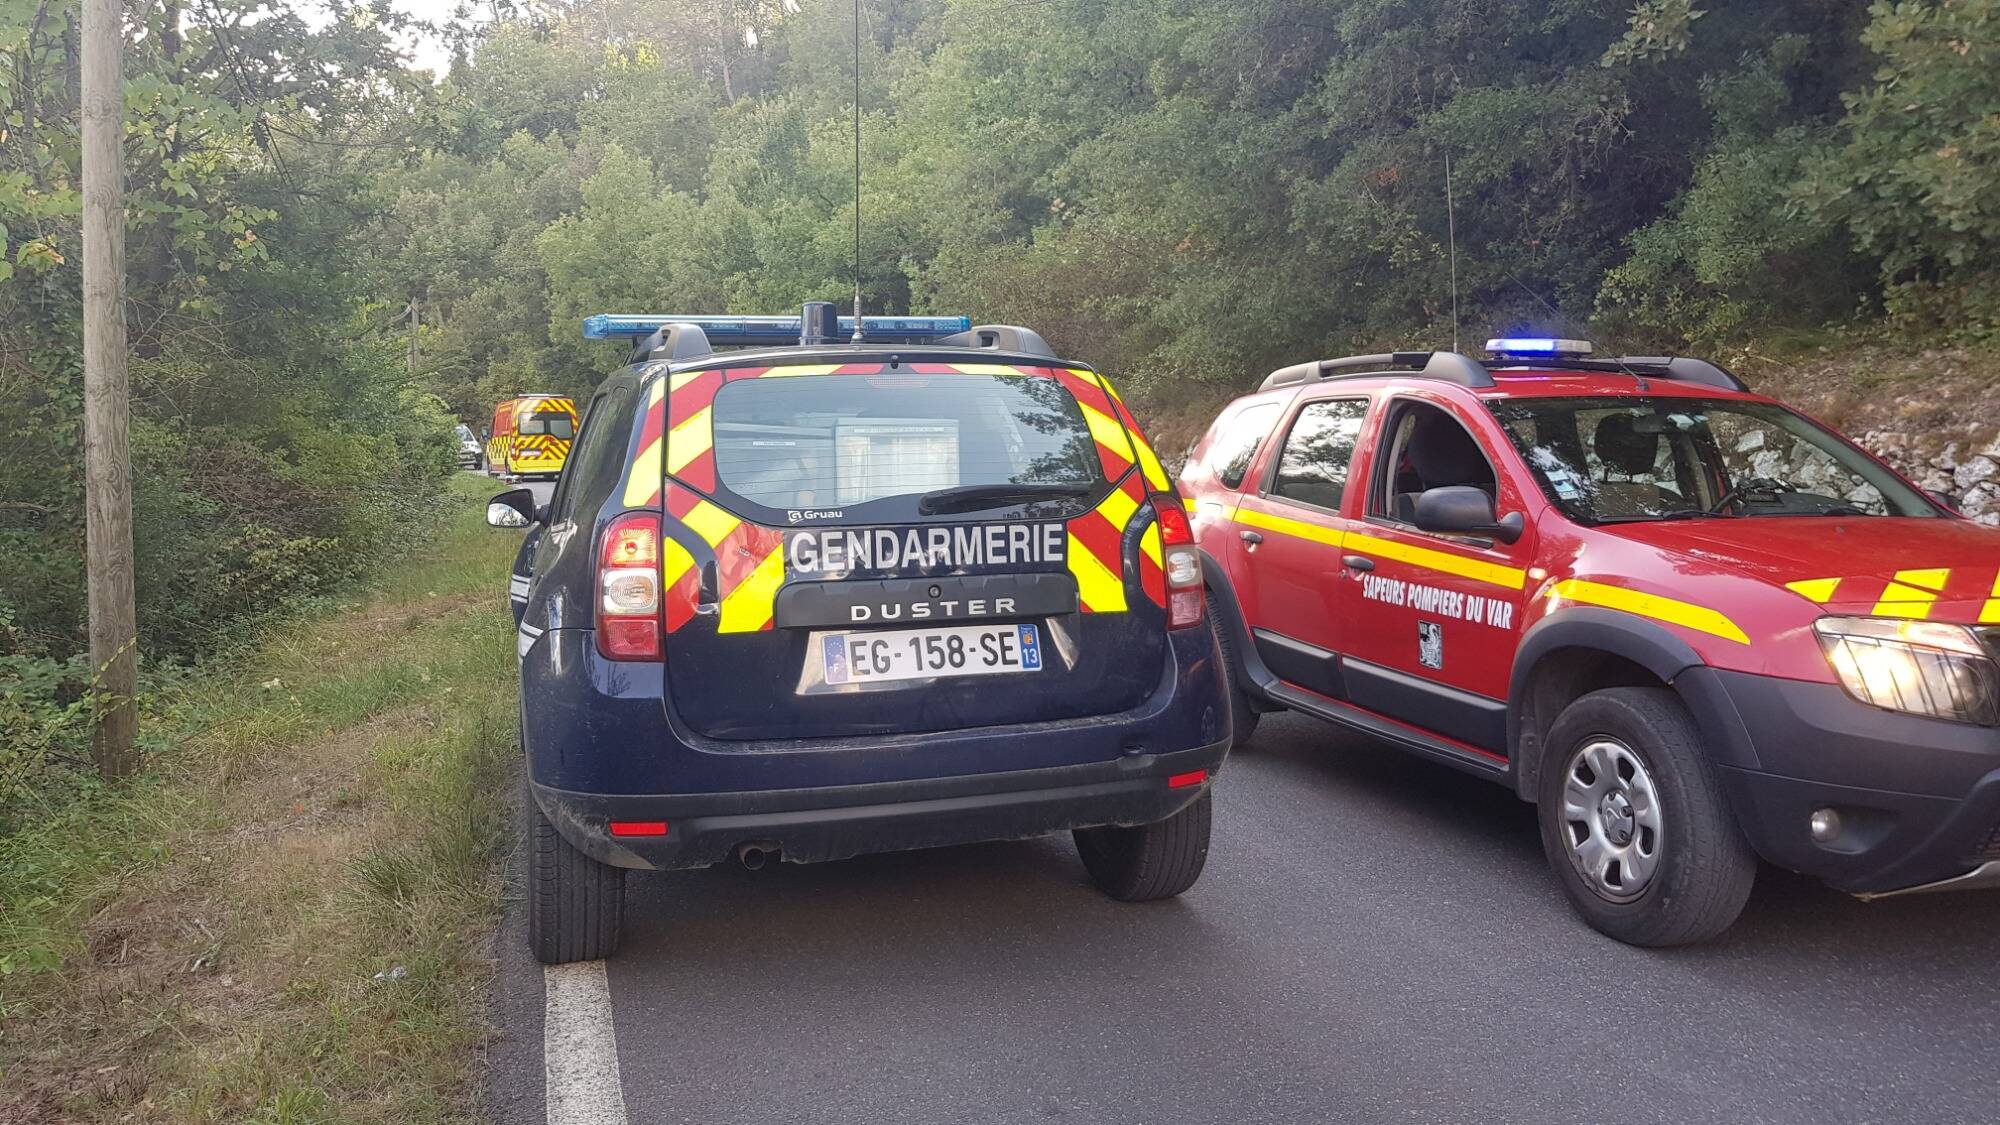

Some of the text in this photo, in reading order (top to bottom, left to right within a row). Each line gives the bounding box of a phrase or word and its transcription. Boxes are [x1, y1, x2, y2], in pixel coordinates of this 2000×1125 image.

[803, 510, 843, 519] Gruau
[790, 523, 1064, 573] GENDARMERIE
[851, 598, 1017, 621] DUSTER
[1362, 574, 1513, 630] SAPEURS POMPIERS DU VAR
[850, 631, 1019, 676] EG-158-SE
[1023, 647, 1038, 664] 13
